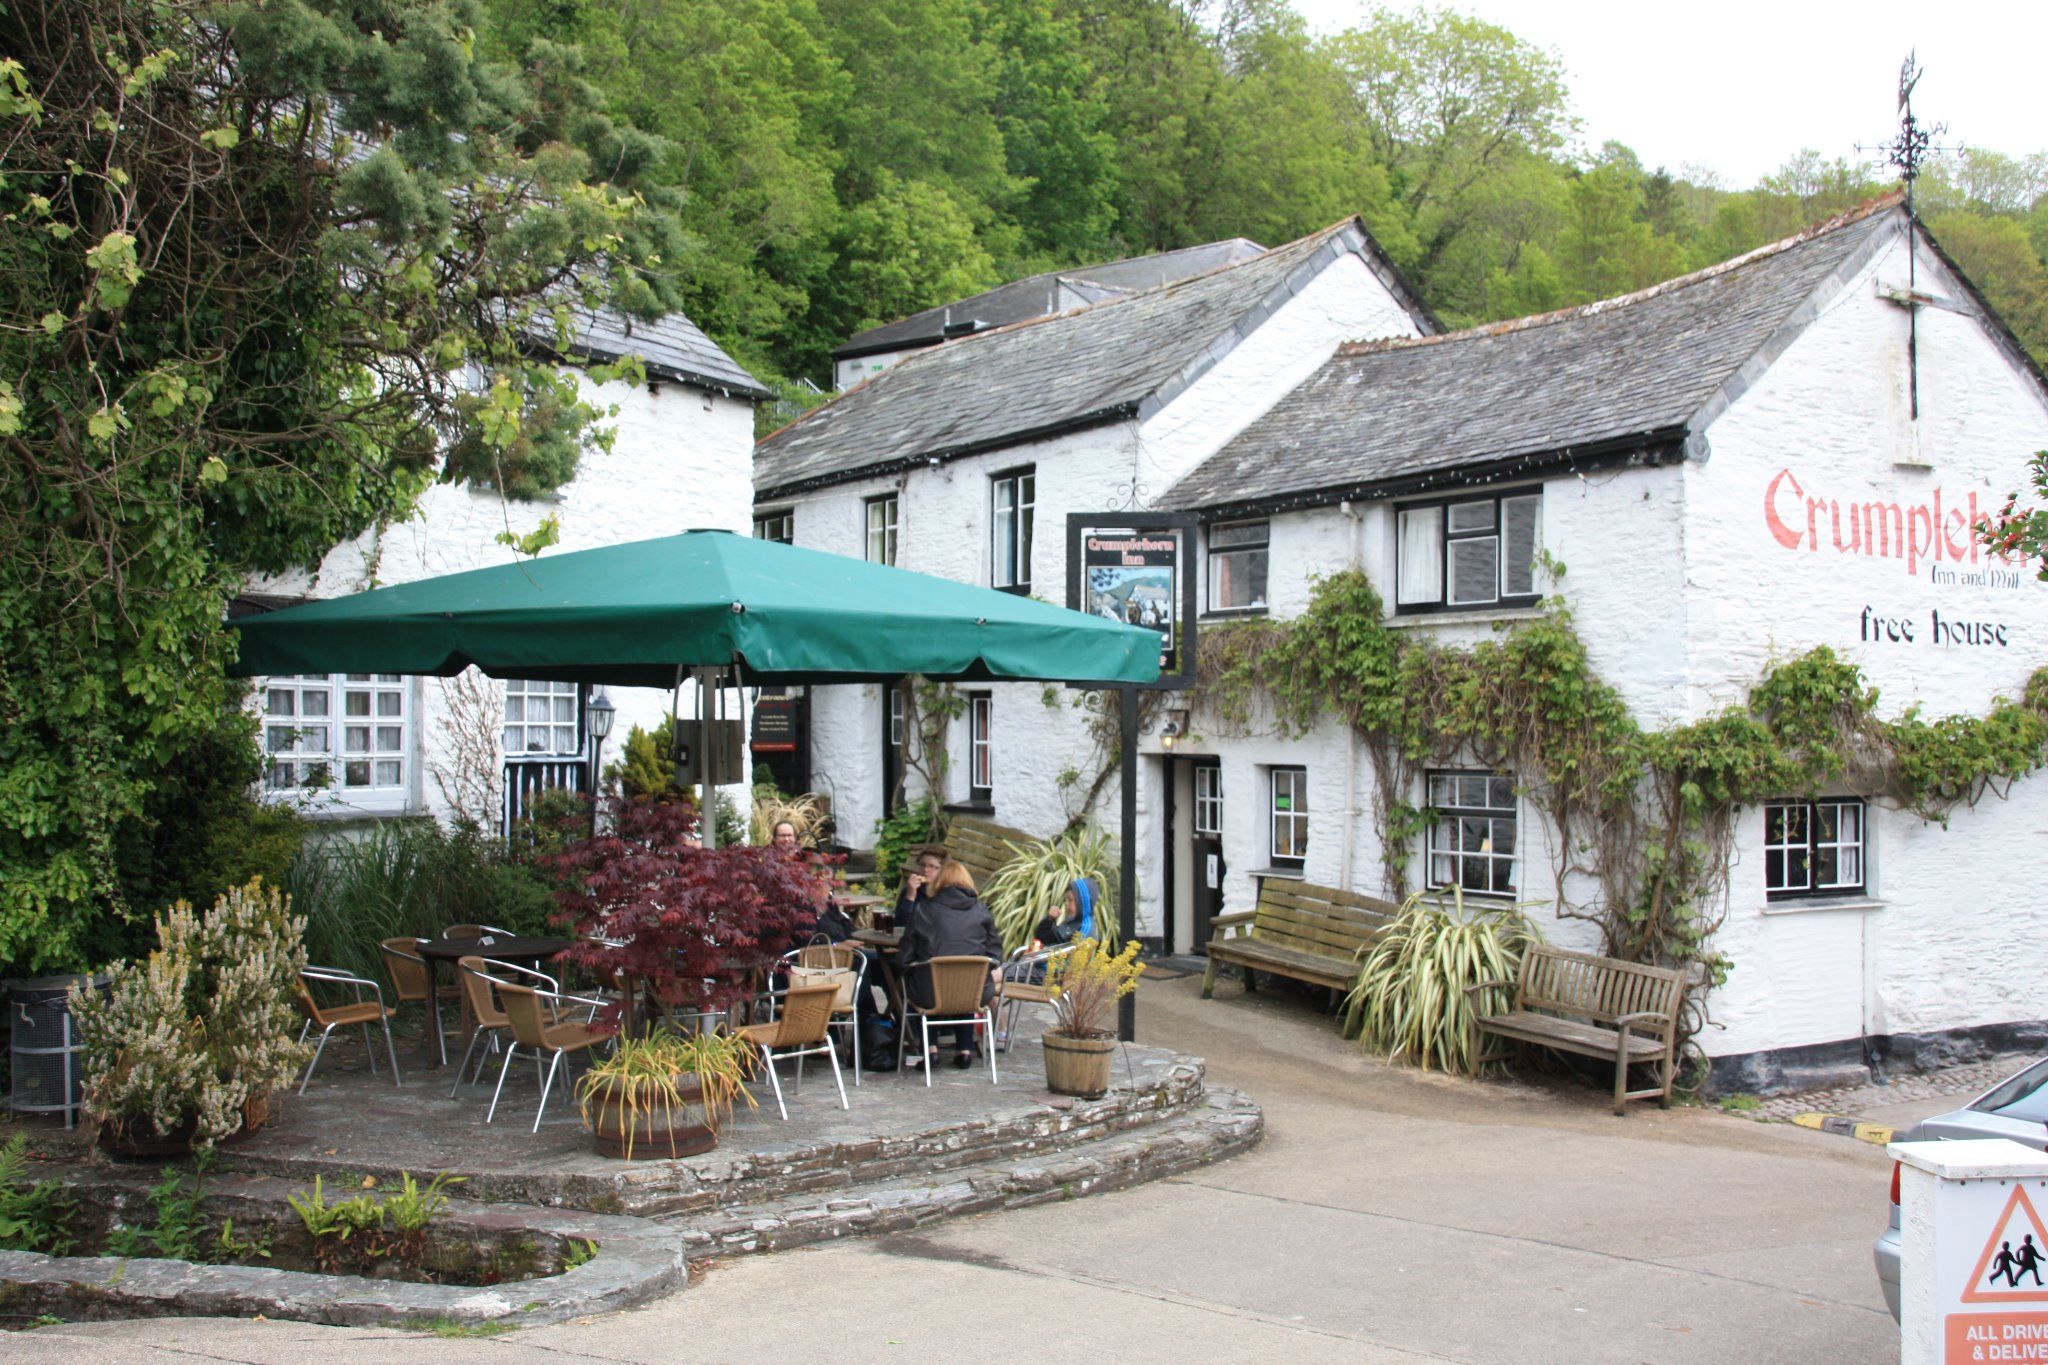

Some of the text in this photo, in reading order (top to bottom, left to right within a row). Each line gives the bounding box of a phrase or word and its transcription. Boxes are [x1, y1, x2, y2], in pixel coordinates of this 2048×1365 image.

[1122, 551, 1145, 565] Inn
[1931, 565, 2019, 589] Inn and Mill
[1860, 604, 2008, 648] free house
[1966, 1325, 1998, 1341] ALL
[1972, 1343, 2048, 1360] & DELIVE
